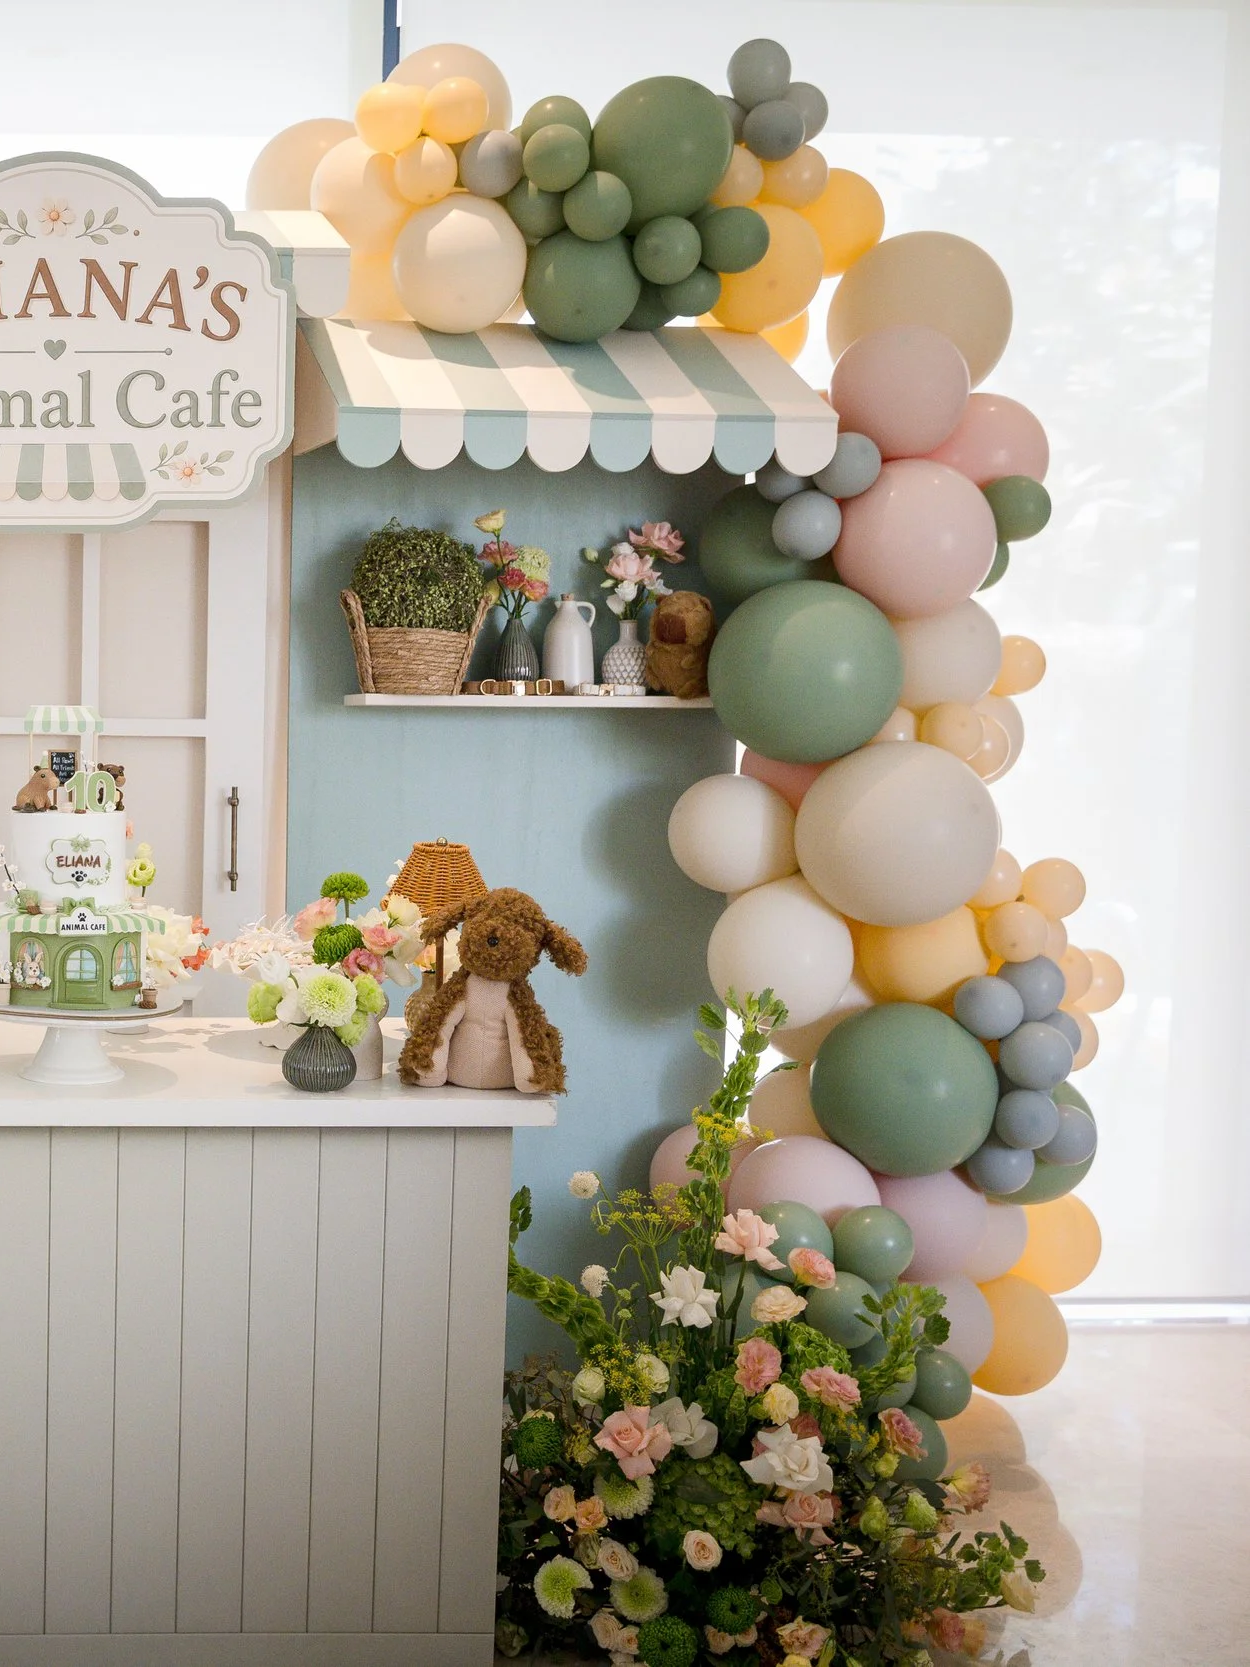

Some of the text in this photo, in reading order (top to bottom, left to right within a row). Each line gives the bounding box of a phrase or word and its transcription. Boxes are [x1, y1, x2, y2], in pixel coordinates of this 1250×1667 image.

[115, 368, 263, 430] Cafe
[64, 770, 116, 813] 10
[56, 854, 102, 868] ELIANA
[61, 923, 106, 931] ANIMAL CAFE
